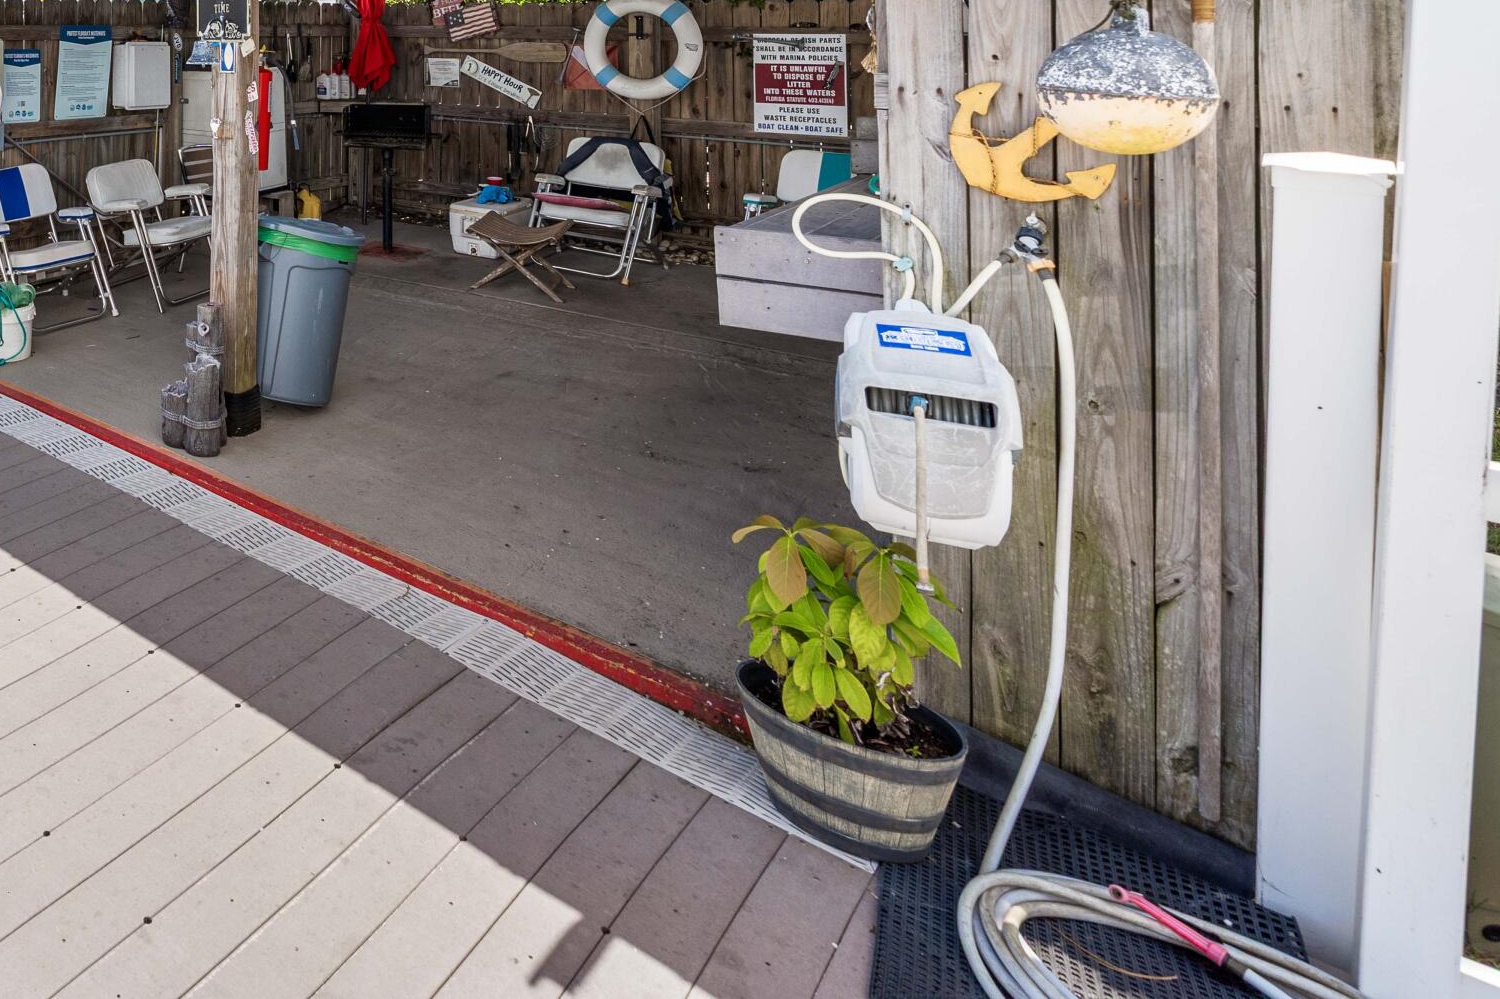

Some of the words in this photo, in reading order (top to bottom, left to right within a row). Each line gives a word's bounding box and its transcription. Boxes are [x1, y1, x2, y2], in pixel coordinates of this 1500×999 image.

[214, 3, 230, 13] TIME
[481, 66, 504, 81] HAPPY
[503, 77, 524, 93] HOUR
[790, 116, 837, 124] RECEPTACLES
